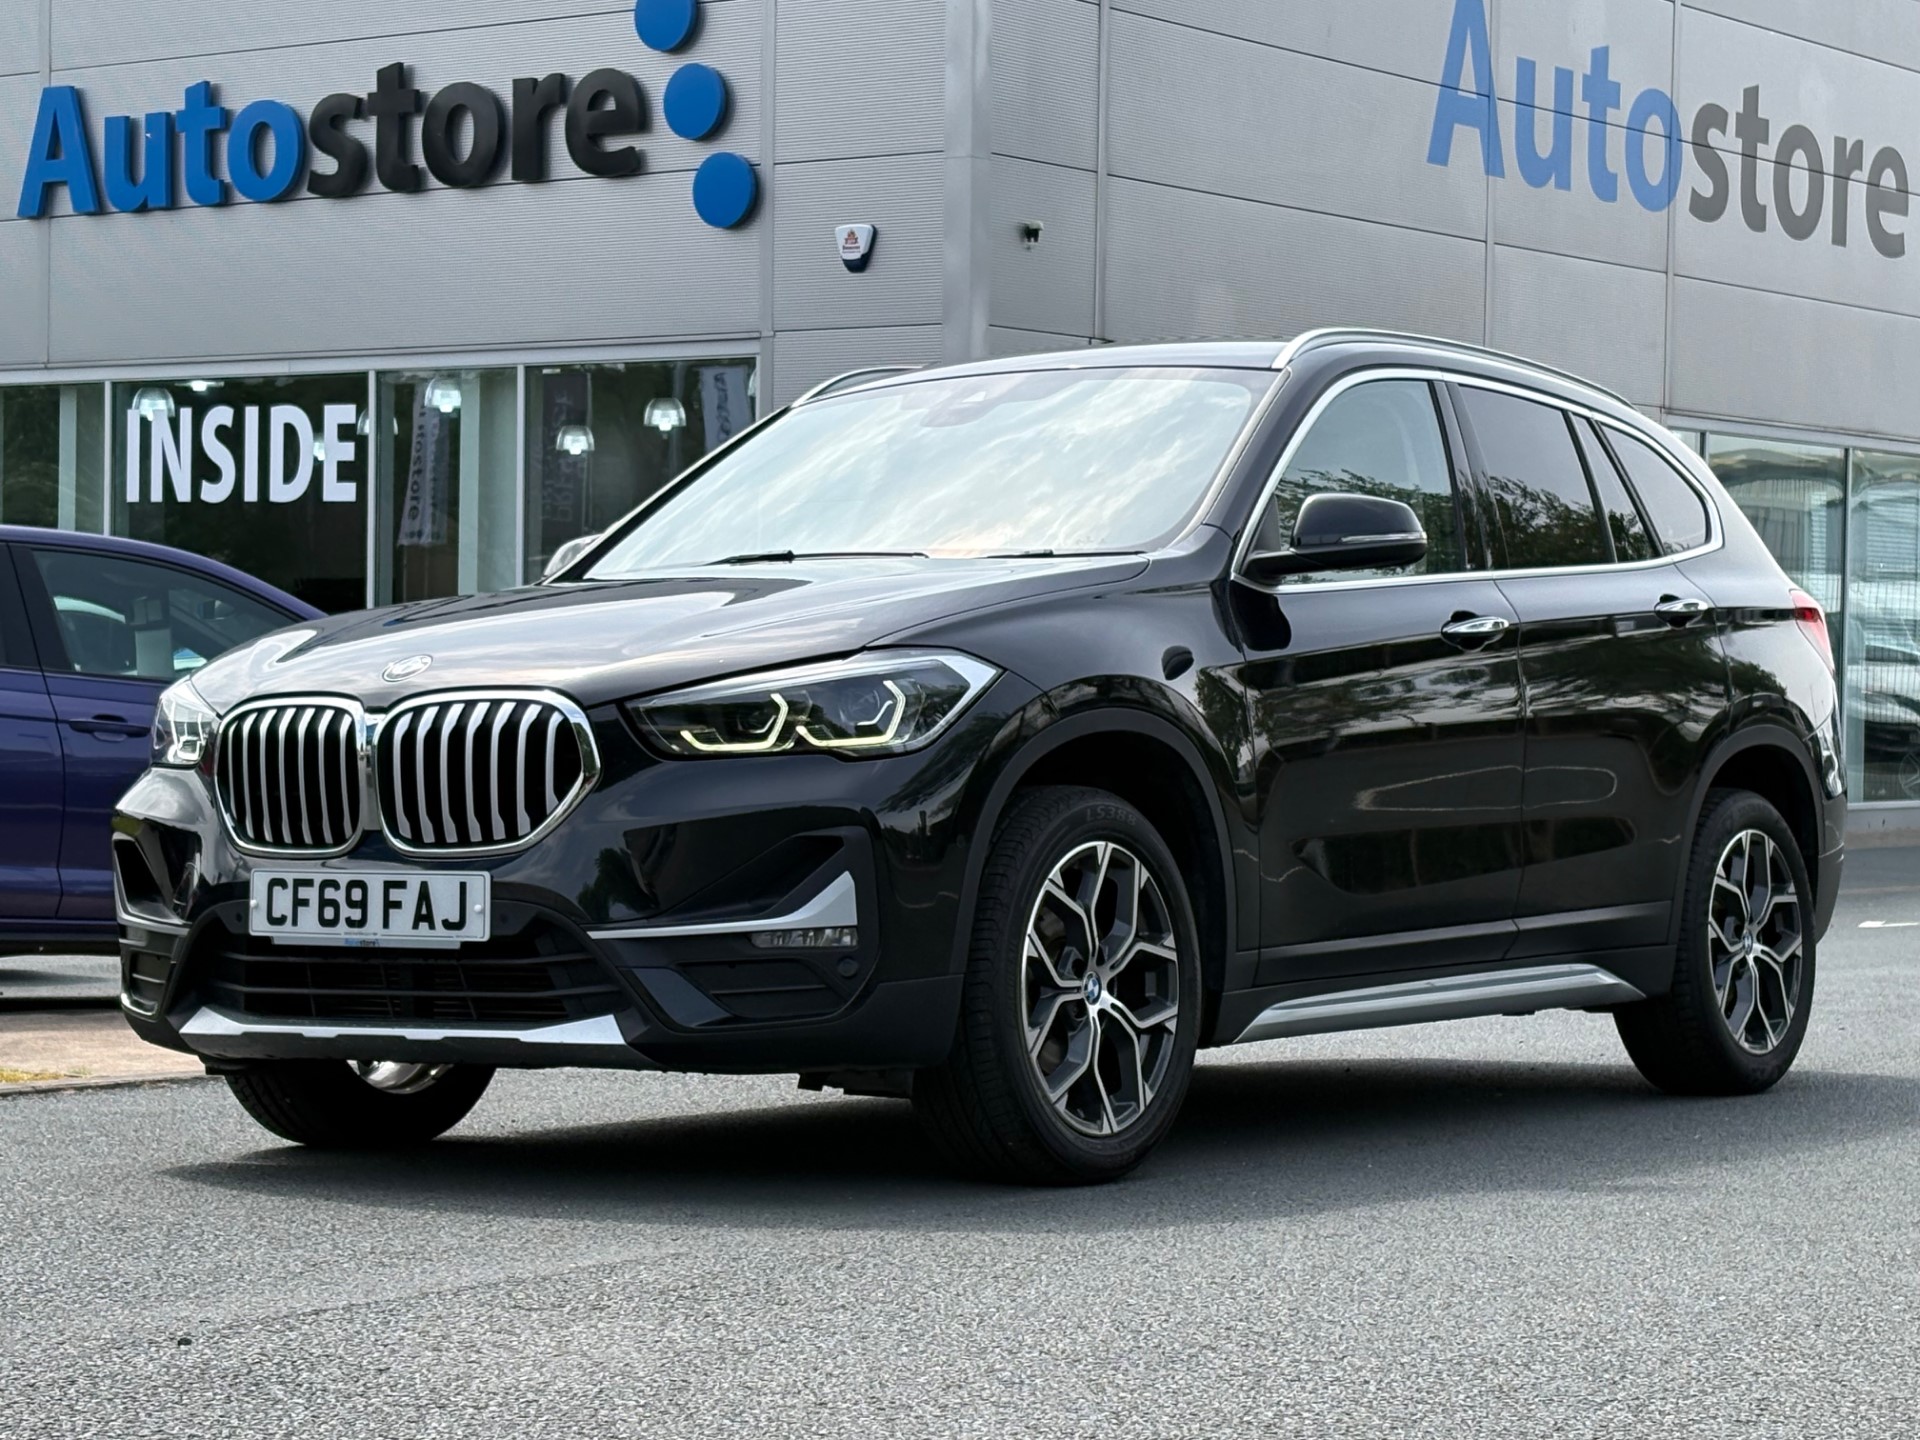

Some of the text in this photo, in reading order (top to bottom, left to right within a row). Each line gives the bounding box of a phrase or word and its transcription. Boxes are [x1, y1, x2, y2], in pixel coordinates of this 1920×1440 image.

[17, 62, 648, 219] Autostore
[1426, 0, 1909, 259] Autostore
[126, 403, 357, 503] INSIDE
[266, 877, 468, 931] CF69 FAJ
